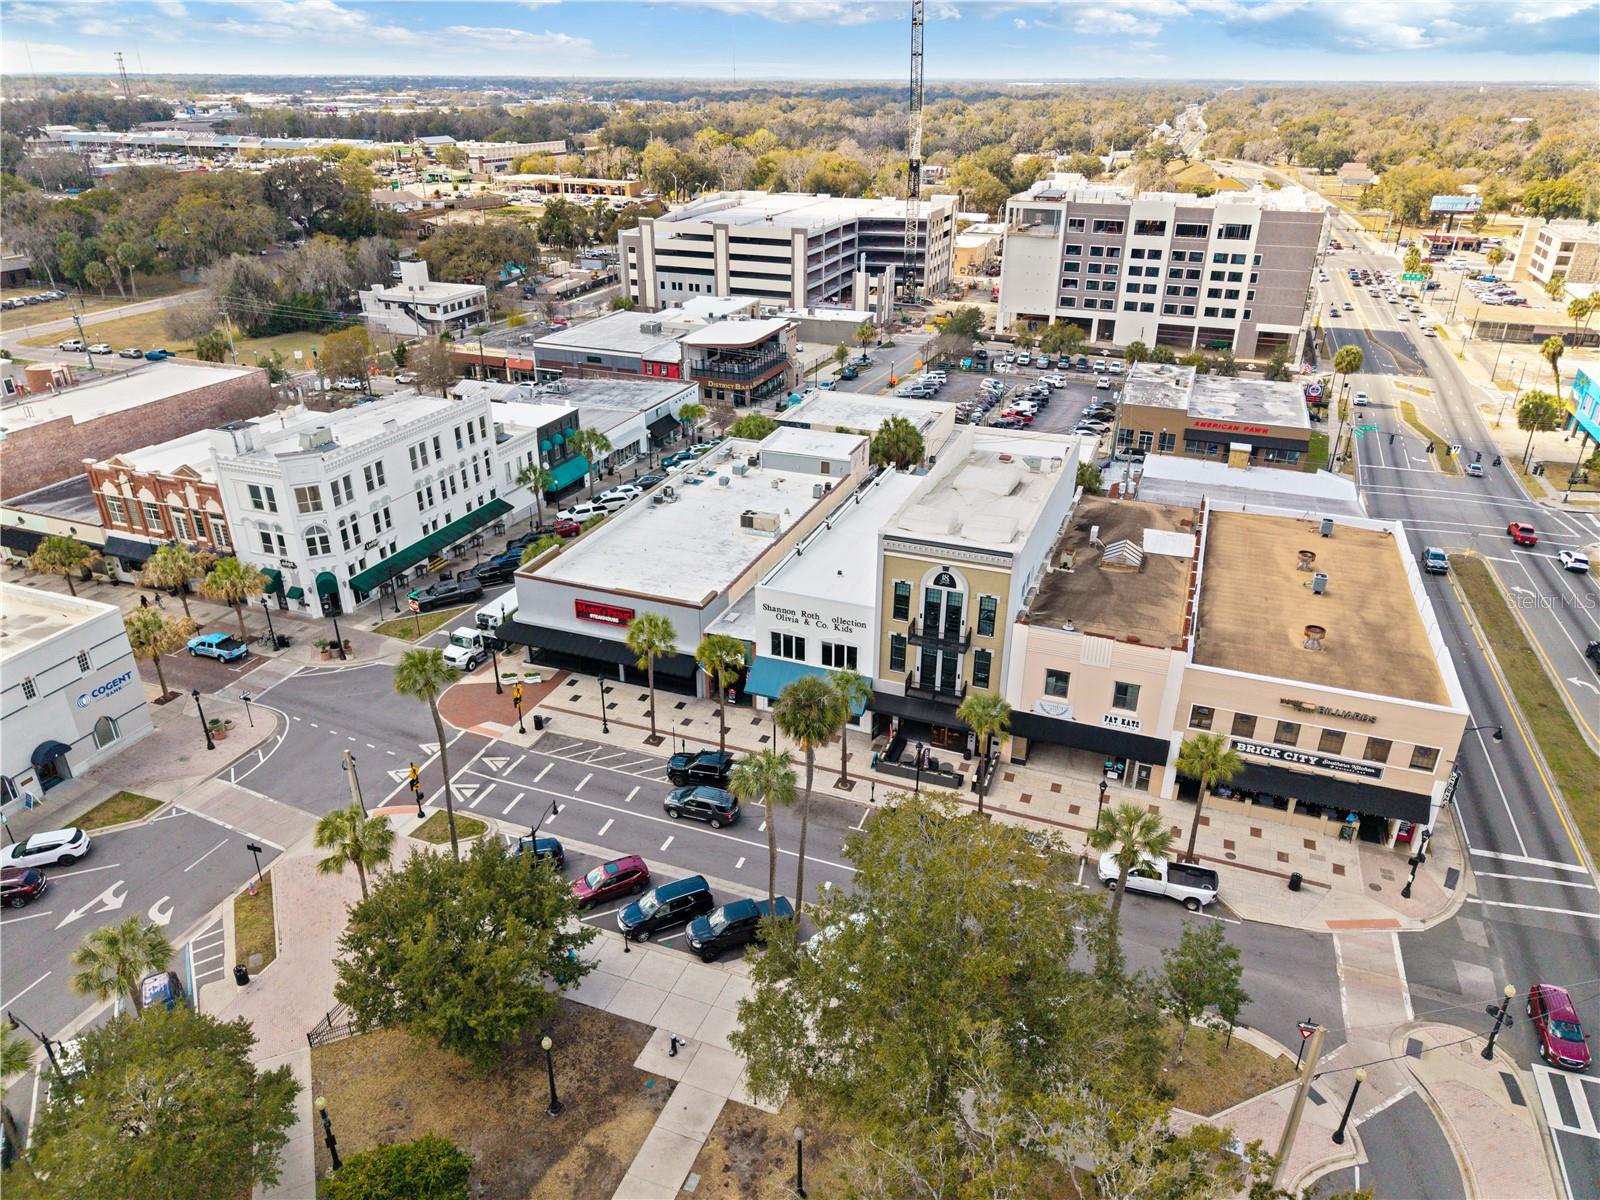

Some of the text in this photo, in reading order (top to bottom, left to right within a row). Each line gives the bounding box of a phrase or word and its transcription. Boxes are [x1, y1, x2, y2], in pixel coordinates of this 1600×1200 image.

[1194, 421, 1270, 434] AMERICAN PAWN
[762, 603, 796, 616] Shannon
[801, 610, 820, 620] Roth
[776, 613, 799, 624] Olivia
[816, 620, 828, 630] Co.
[834, 624, 853, 634] Kids
[91, 670, 132, 698] COGENT
[106, 687, 122, 698] BANK
[1121, 718, 1140, 728] KATS
[1318, 706, 1377, 724] BILLIARDS
[1236, 742, 1319, 765] BRICK CITY
[1322, 758, 1375, 773] Southern Kitchen
